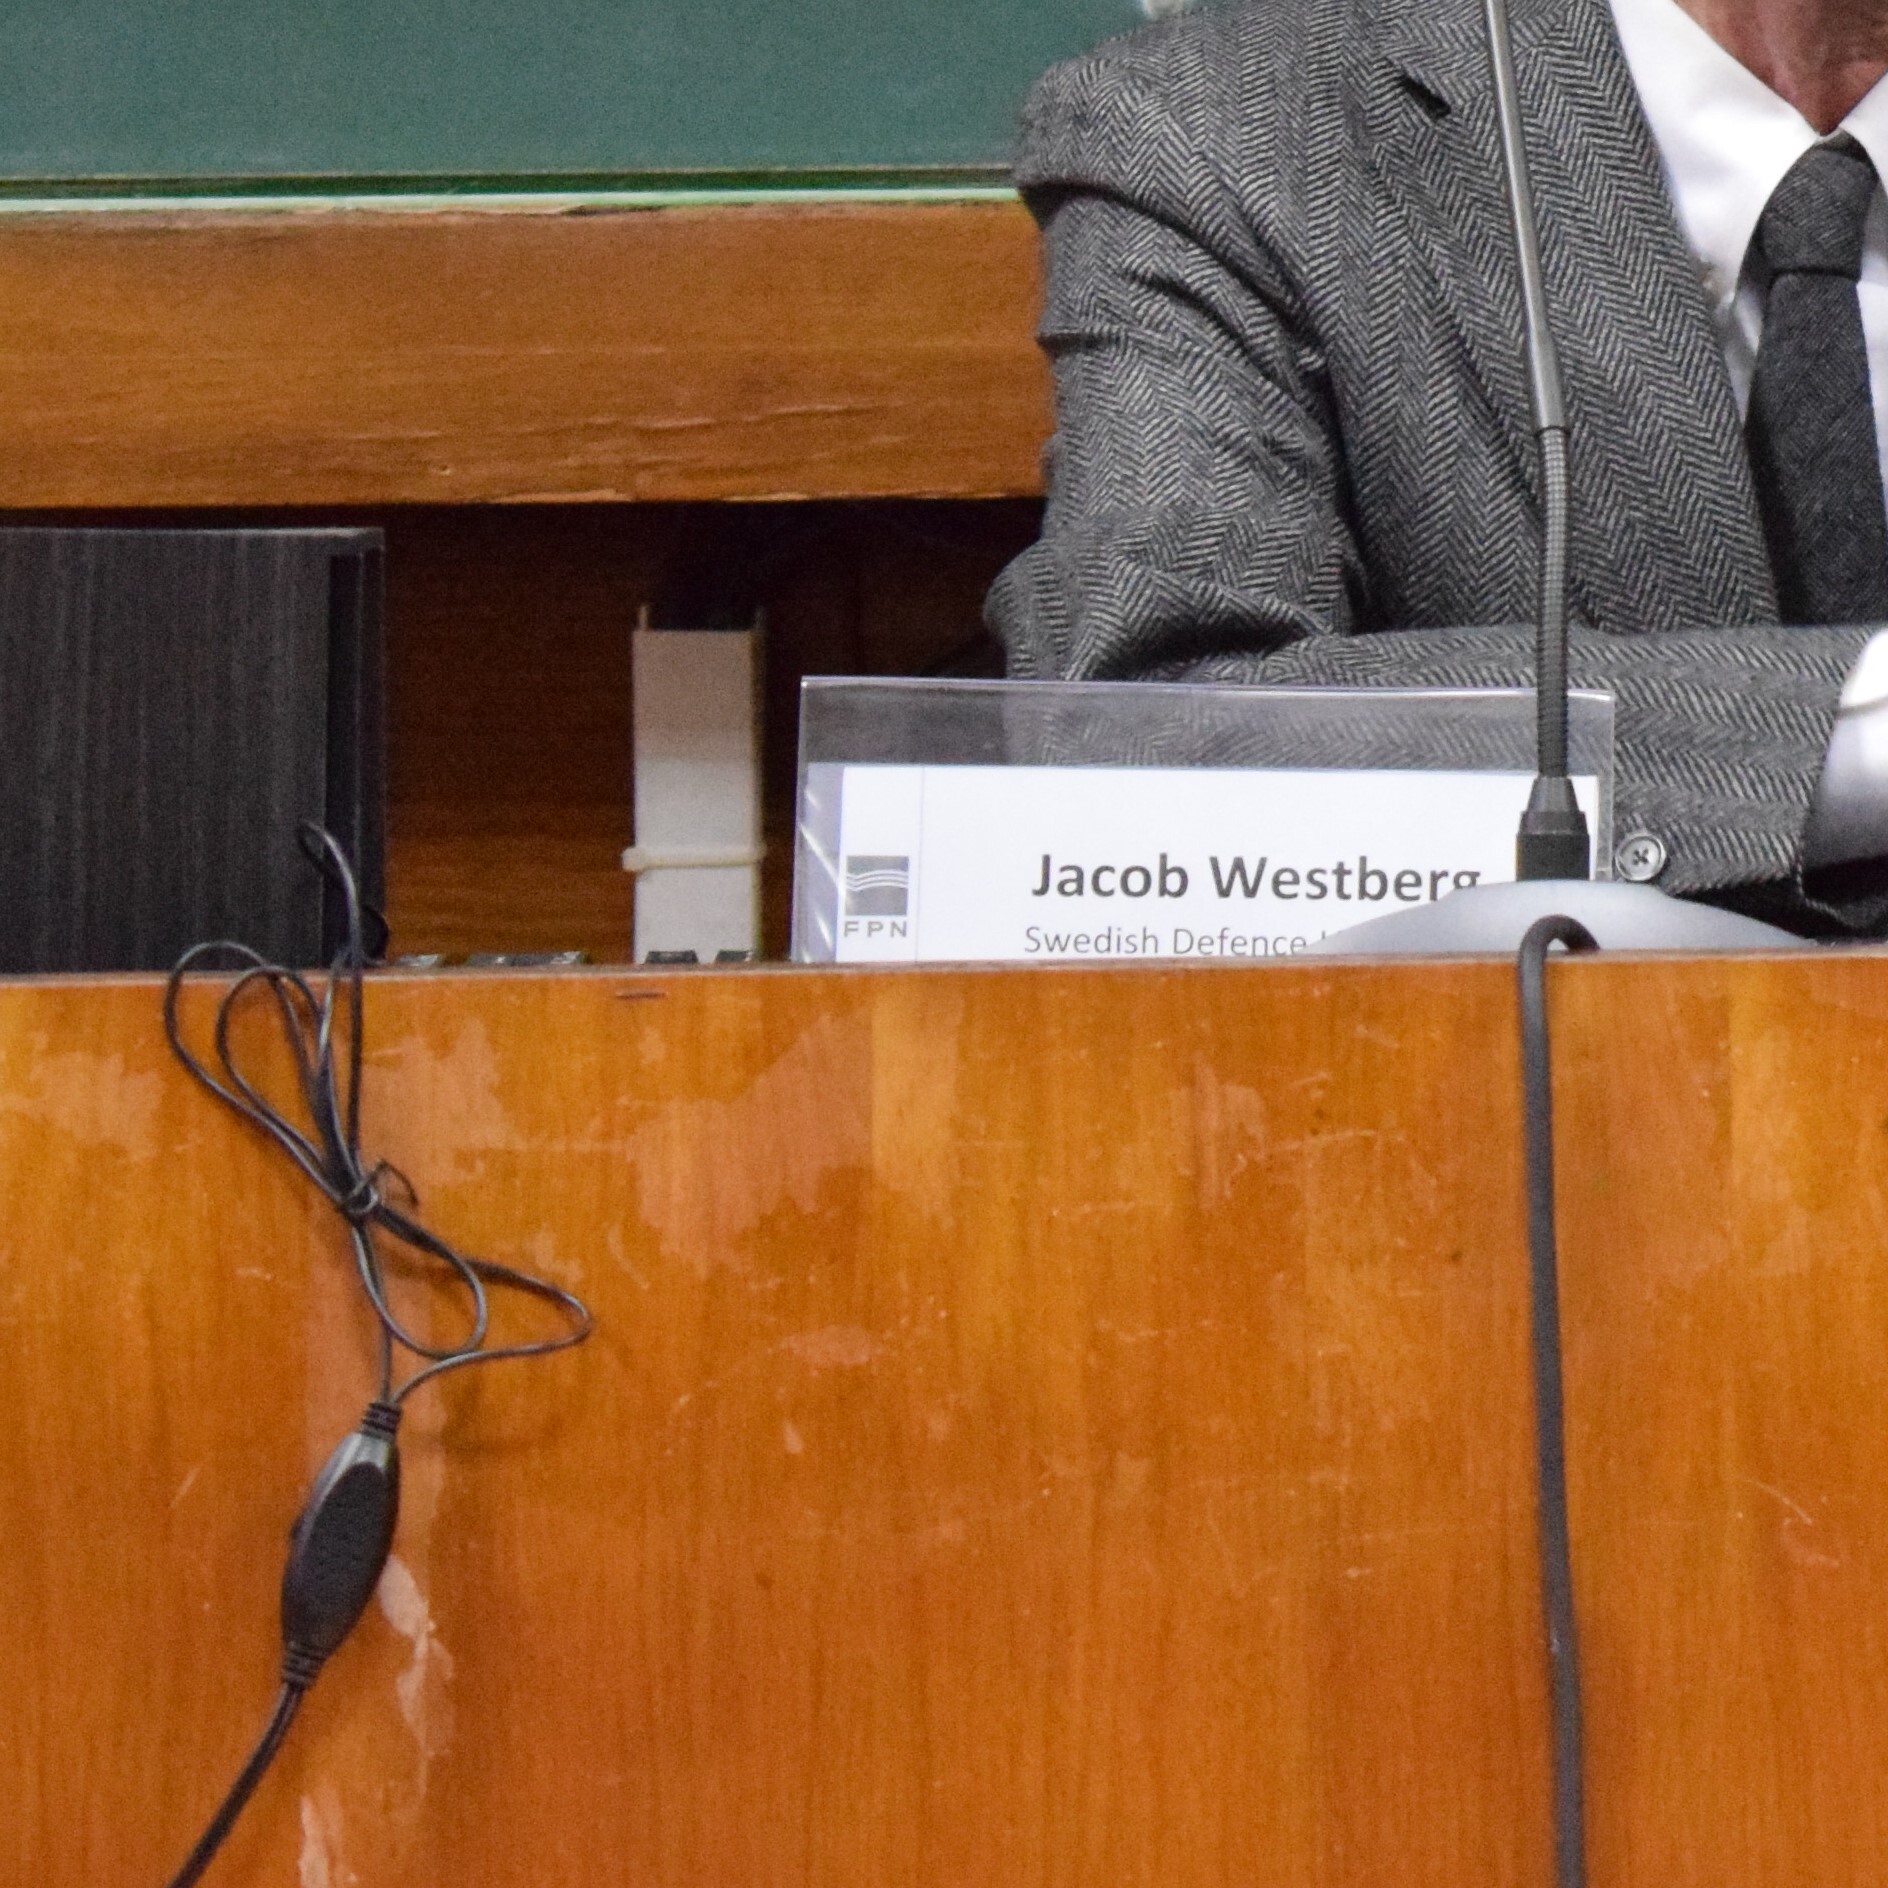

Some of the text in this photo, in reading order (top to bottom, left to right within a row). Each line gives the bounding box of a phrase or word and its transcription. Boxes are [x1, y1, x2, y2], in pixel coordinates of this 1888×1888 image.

[1031, 852, 1190, 898] Jacob
[844, 921, 907, 937] FPN
[1024, 925, 1306, 956] Swedish Defence
